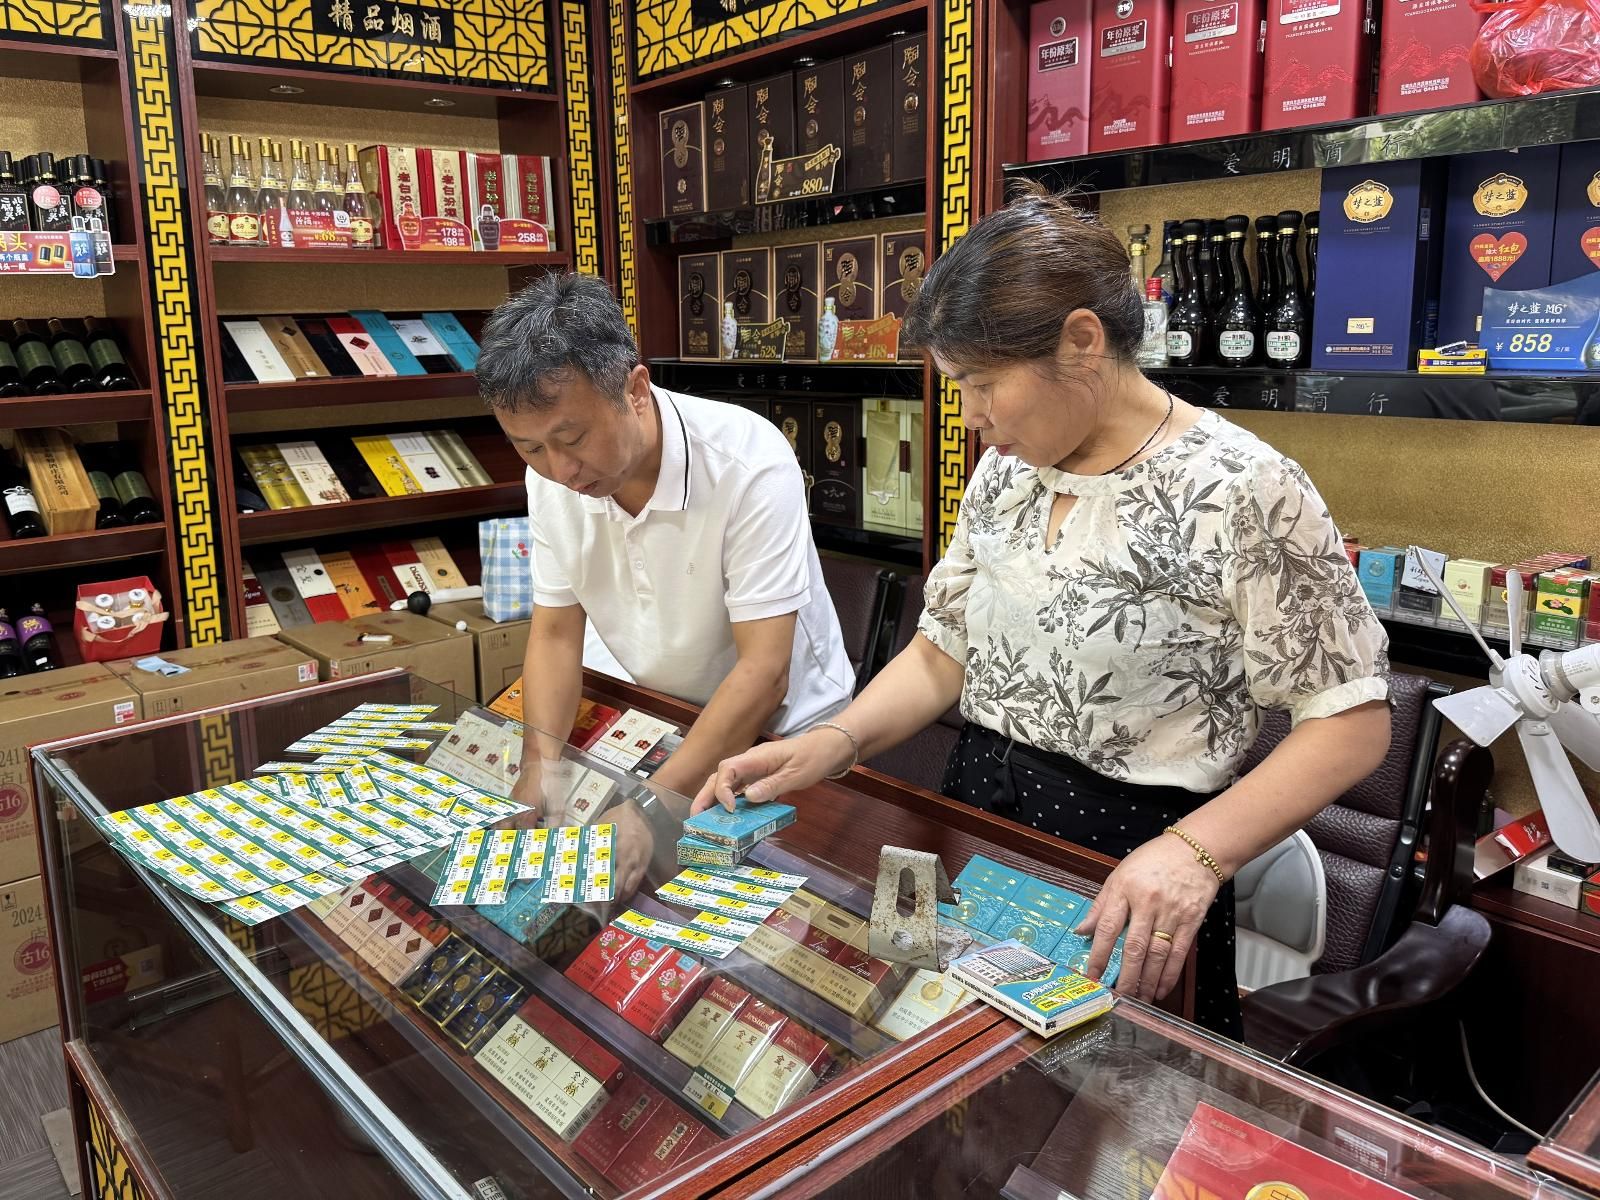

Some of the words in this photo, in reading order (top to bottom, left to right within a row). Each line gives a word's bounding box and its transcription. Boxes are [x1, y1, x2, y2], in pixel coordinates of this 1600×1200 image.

[328, 0, 442, 44] 精品烟酒
[1192, 6, 1234, 25] 年份原浆
[1107, 22, 1143, 41] 年份原浆
[1041, 41, 1076, 61] 年份原浆
[1223, 134, 1403, 174] 爱明商行
[802, 177, 823, 195] 880
[1352, 194, 1384, 209] 梦之蓝
[1484, 188, 1517, 206] 梦之蓝
[1499, 243, 1521, 255] 红包
[1508, 302, 1541, 317] 梦之蓝
[760, 345, 777, 358] 528
[1509, 333, 1553, 353] 858
[1213, 386, 1390, 415] 爱明商行
[20, 946, 51, 967] 古16
